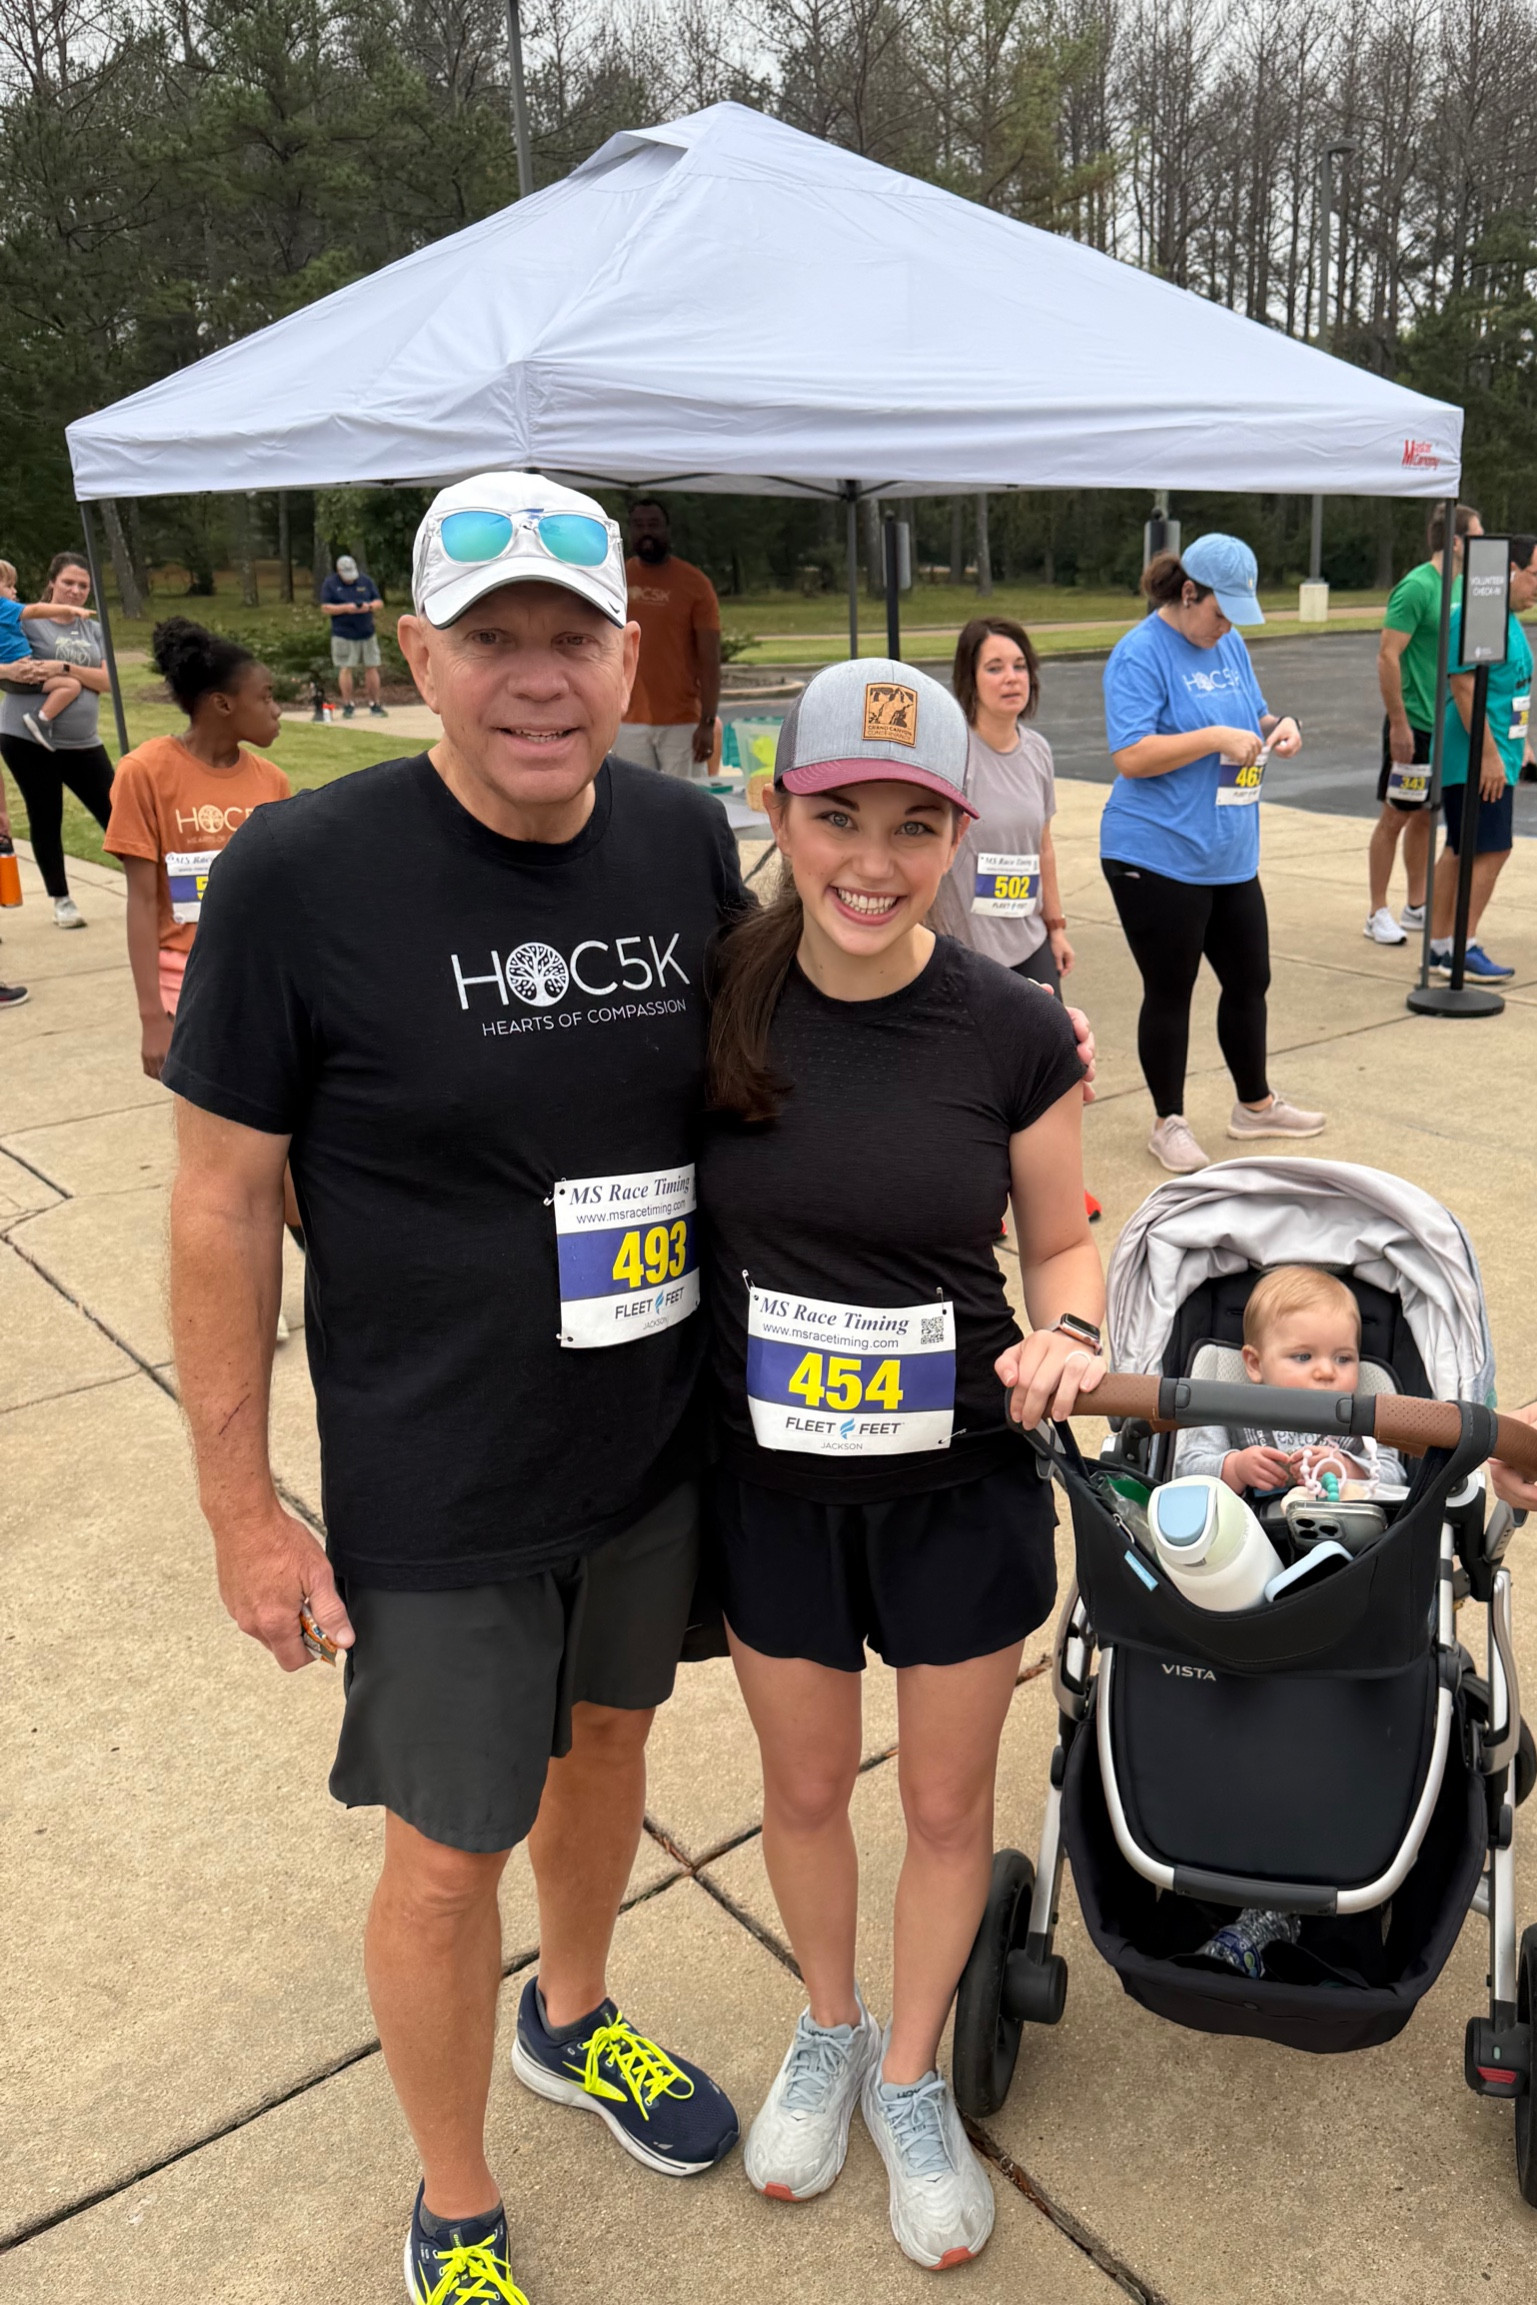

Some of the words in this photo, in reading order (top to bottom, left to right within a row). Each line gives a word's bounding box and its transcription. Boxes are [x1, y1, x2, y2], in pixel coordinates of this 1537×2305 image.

[1471, 576, 1504, 586] VOLUNTEER
[994, 876, 1030, 898] 502
[482, 1015, 554, 1037] HEARTS
[558, 1011, 582, 1029] OF
[587, 999, 687, 1024] COMPASSION
[569, 1185, 602, 1206] MS
[608, 1183, 649, 1202] Race
[654, 1175, 690, 1197] Timing
[576, 1199, 686, 1224] www.msracetiming.com
[612, 1220, 687, 1289] 493
[615, 1299, 653, 1319] FLEET
[665, 1287, 685, 1307] FEET
[759, 1297, 790, 1318] MS
[794, 1306, 837, 1327] Race
[844, 1312, 910, 1336] Timing
[762, 1323, 899, 1350] www.msracetiming.com
[788, 1352, 903, 1411] 454
[785, 1417, 836, 1434] FLEET
[859, 1422, 901, 1435] FEET
[820, 1442, 863, 1450] JACKSON
[1161, 1663, 1216, 1681] VISTA
